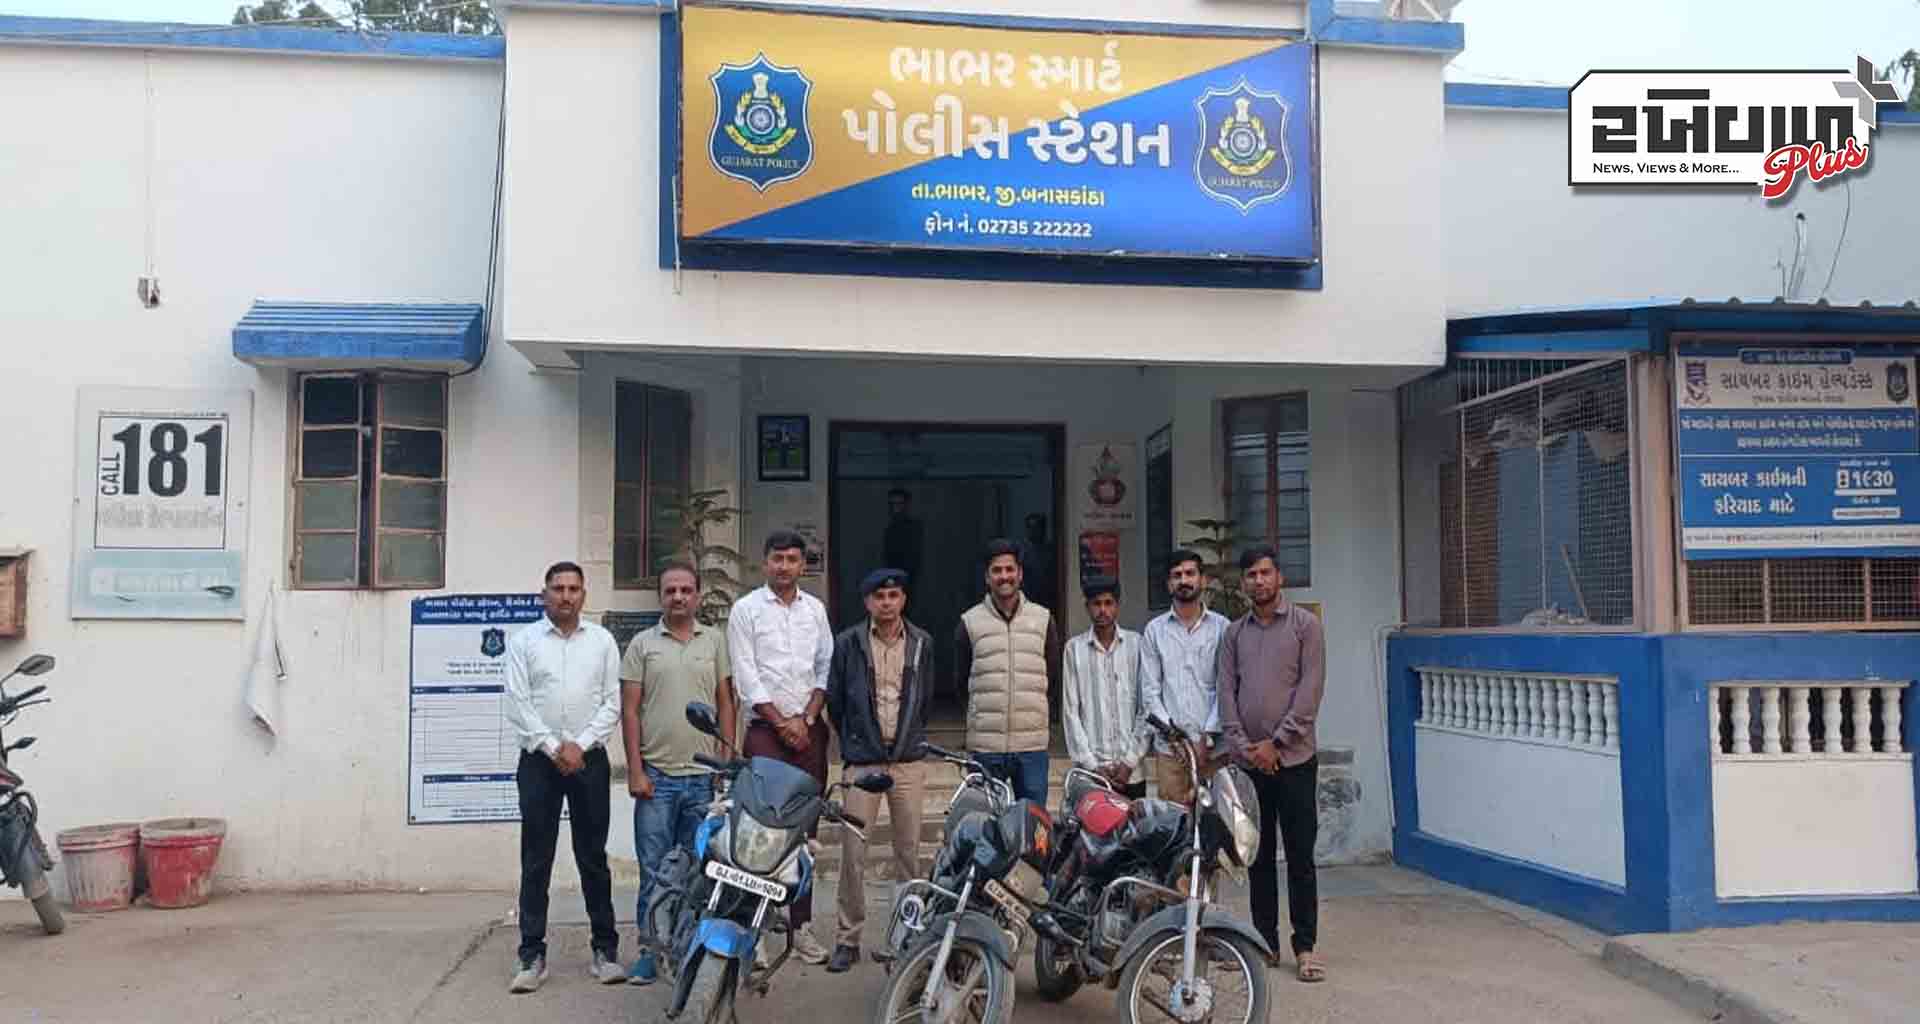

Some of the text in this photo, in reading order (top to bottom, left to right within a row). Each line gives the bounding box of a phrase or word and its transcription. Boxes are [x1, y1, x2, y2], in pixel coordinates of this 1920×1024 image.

[889, 39, 1124, 92] ભાભર સ્માર્ટ
[842, 88, 1171, 167] પોલીસ સ્ટેશન
[925, 210, 954, 236] ફોન
[978, 218, 1029, 234] 02735
[1032, 220, 1093, 238] 222222
[101, 452, 120, 495] CALL
[112, 422, 223, 497] 181
[1699, 471, 1748, 488] સાયબર
[1770, 493, 1796, 513] માટે
